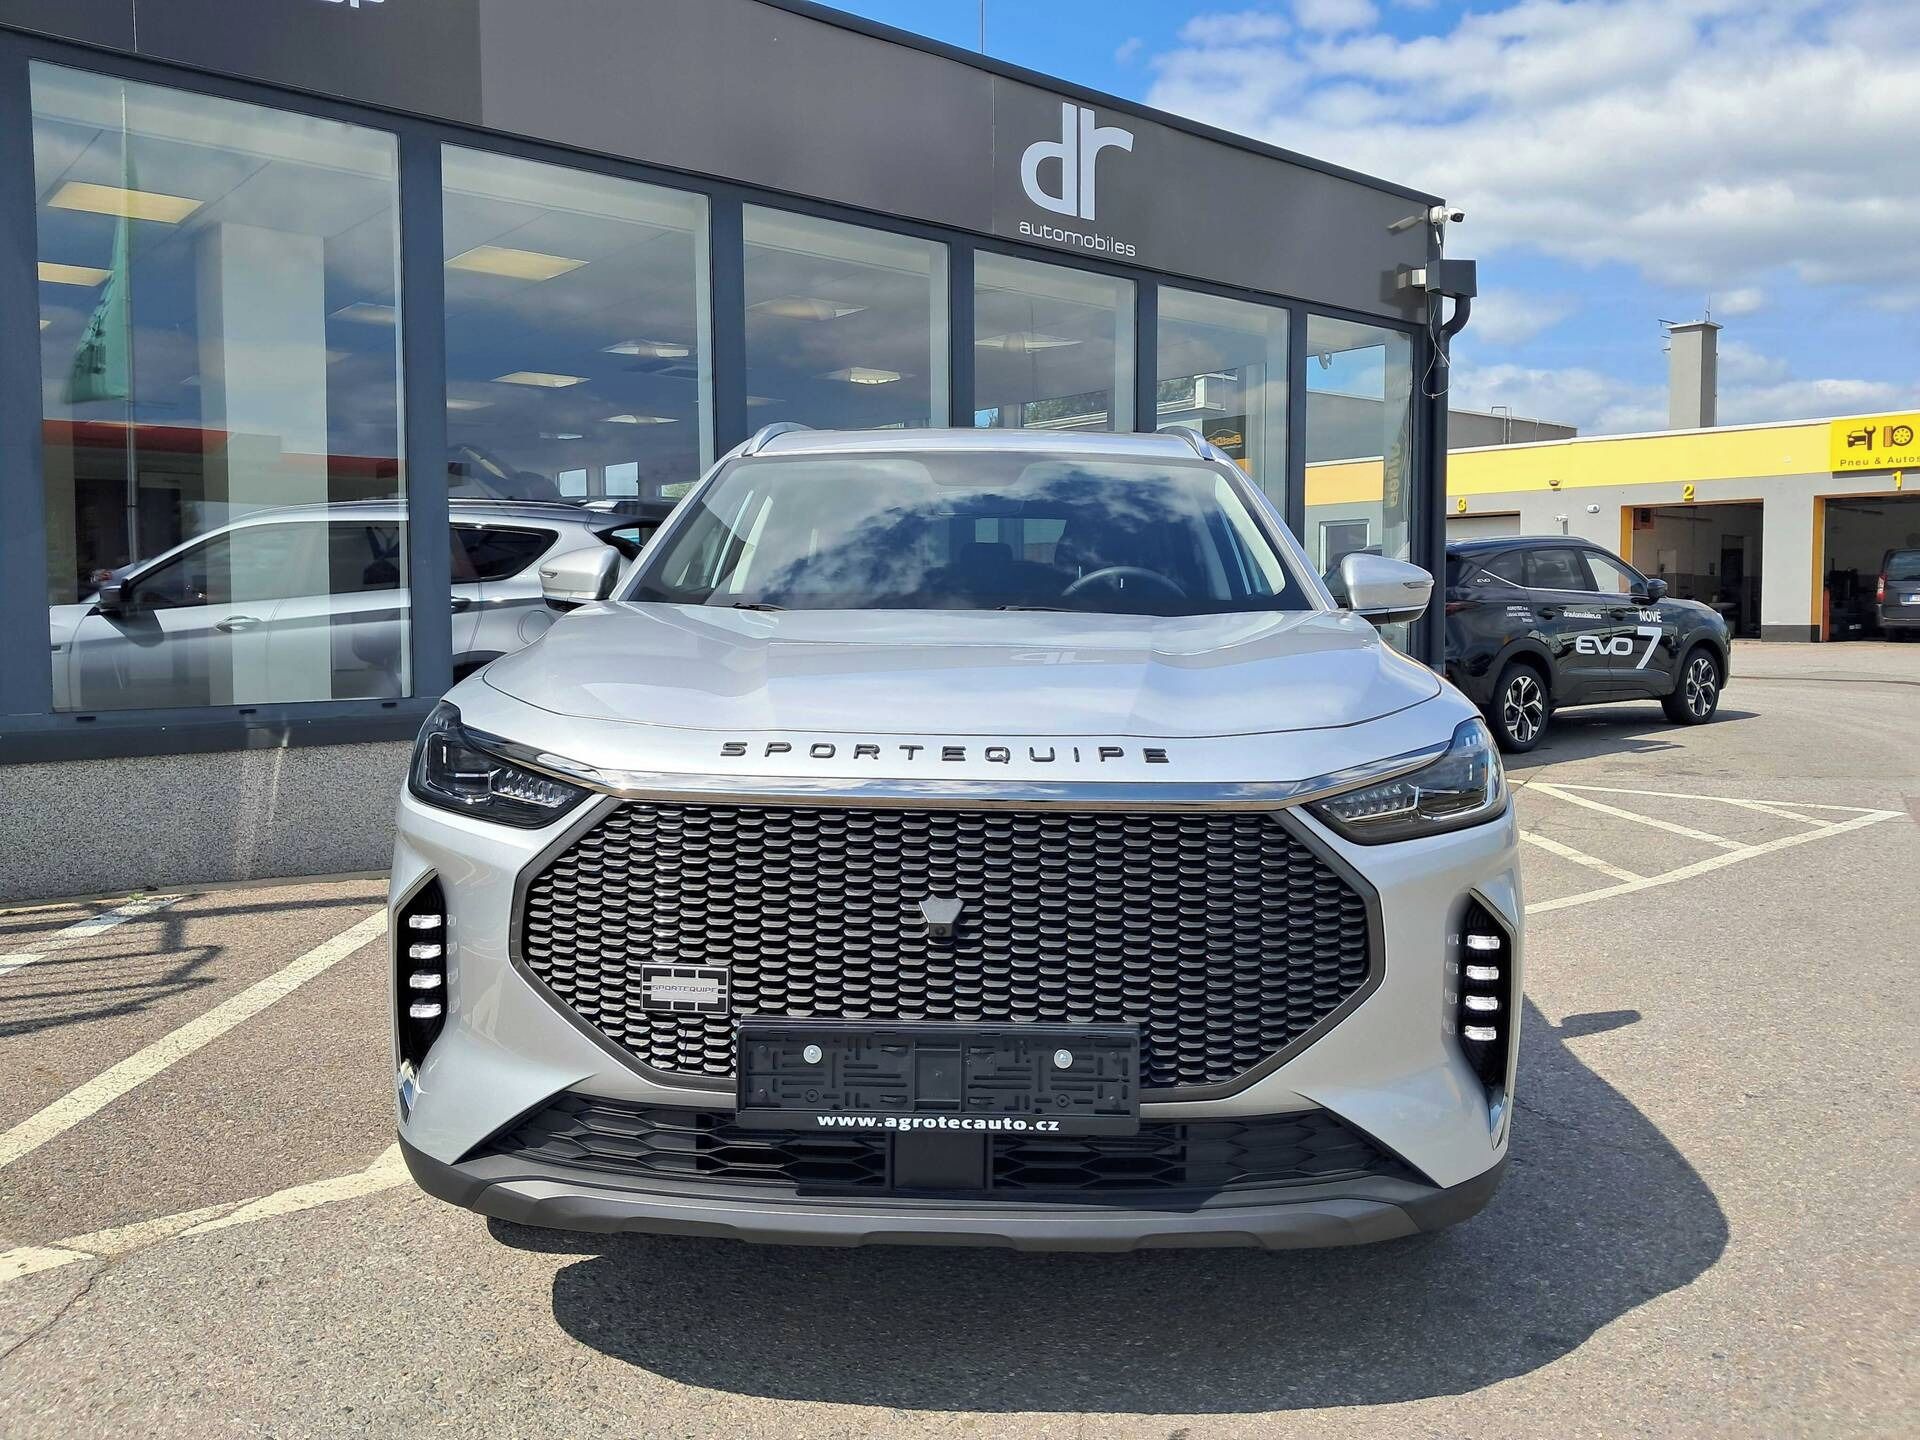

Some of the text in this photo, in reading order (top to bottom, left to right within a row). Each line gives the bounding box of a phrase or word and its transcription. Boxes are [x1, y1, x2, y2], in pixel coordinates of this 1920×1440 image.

[1020, 102, 1135, 221] dr
[1019, 221, 1137, 257] automobiles
[1874, 456, 1881, 465] &
[1892, 470, 1903, 491] 1
[1683, 484, 1695, 501] 2
[1457, 497, 1467, 513] 3
[1575, 626, 1663, 670] EVO 7
[720, 741, 1170, 765] SPORTEQUIPE
[817, 1115, 1060, 1131] www.agrotecauto.cz
